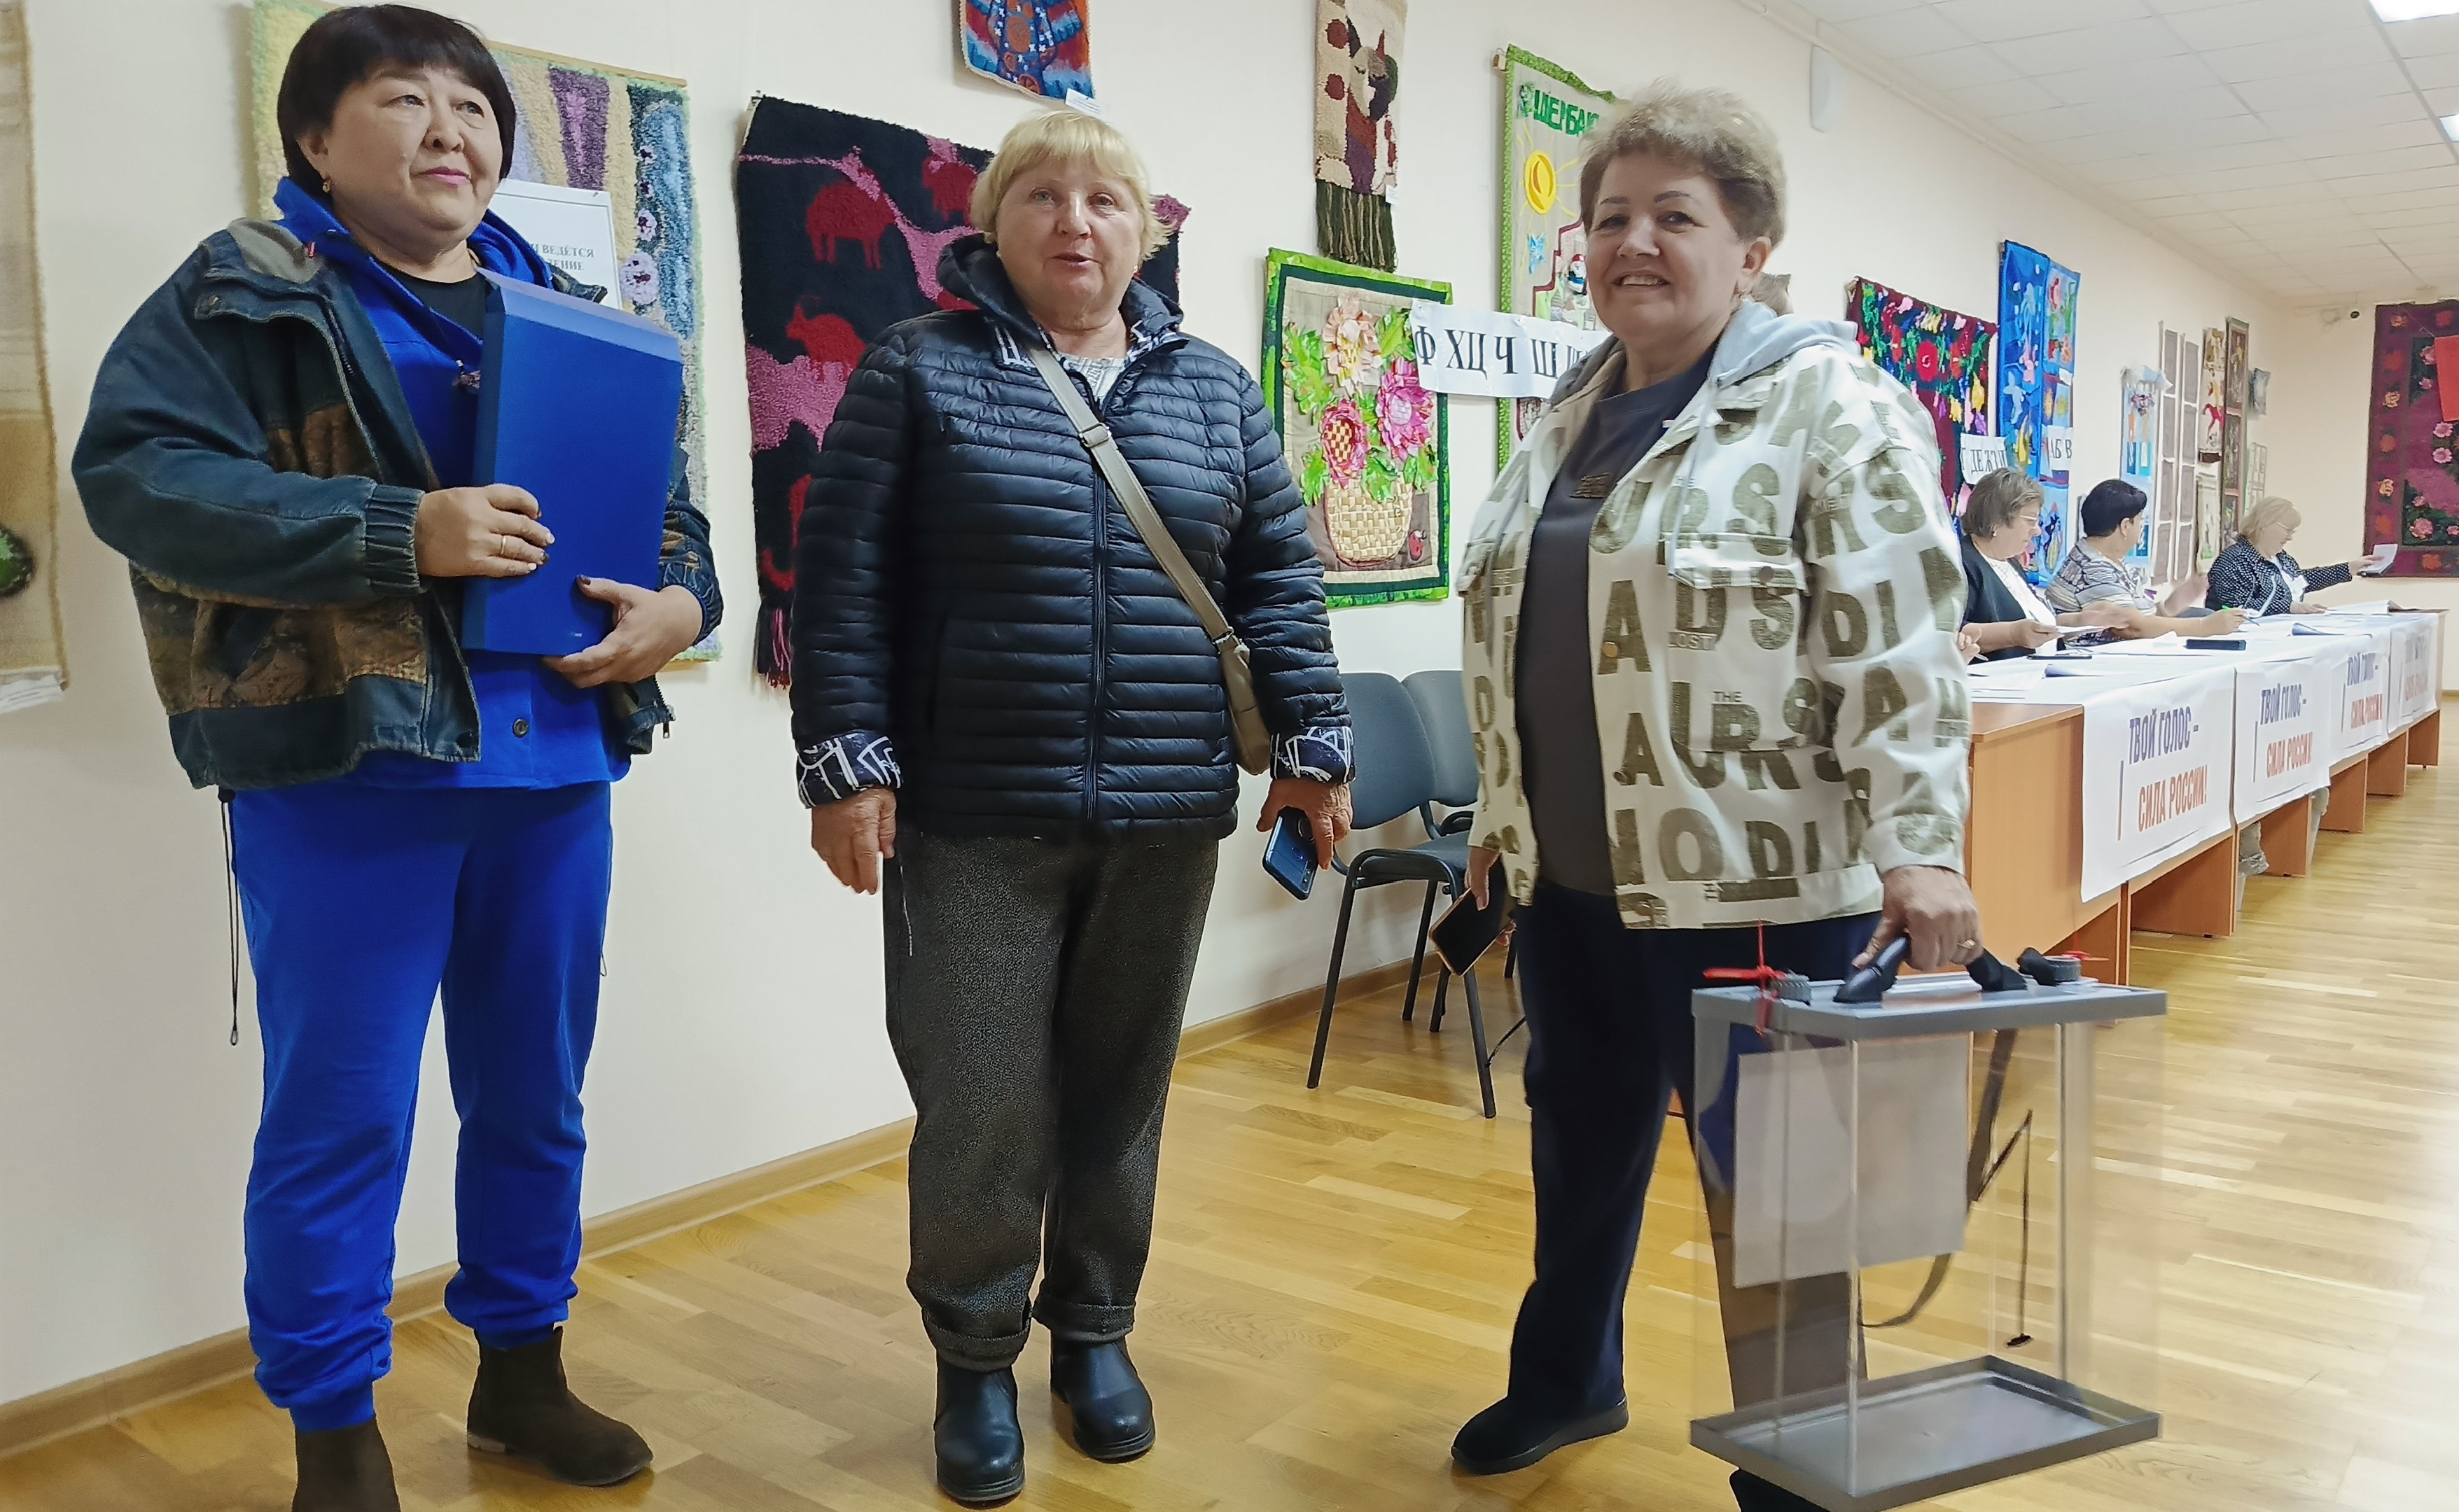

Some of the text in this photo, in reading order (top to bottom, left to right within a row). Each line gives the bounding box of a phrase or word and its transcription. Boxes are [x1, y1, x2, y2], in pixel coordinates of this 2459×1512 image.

[2129, 708, 2157, 764] ТВОЙ
[2158, 706, 2192, 756] ГОЛОС
[2138, 764, 2208, 832] СИЛА РОССИИ!
